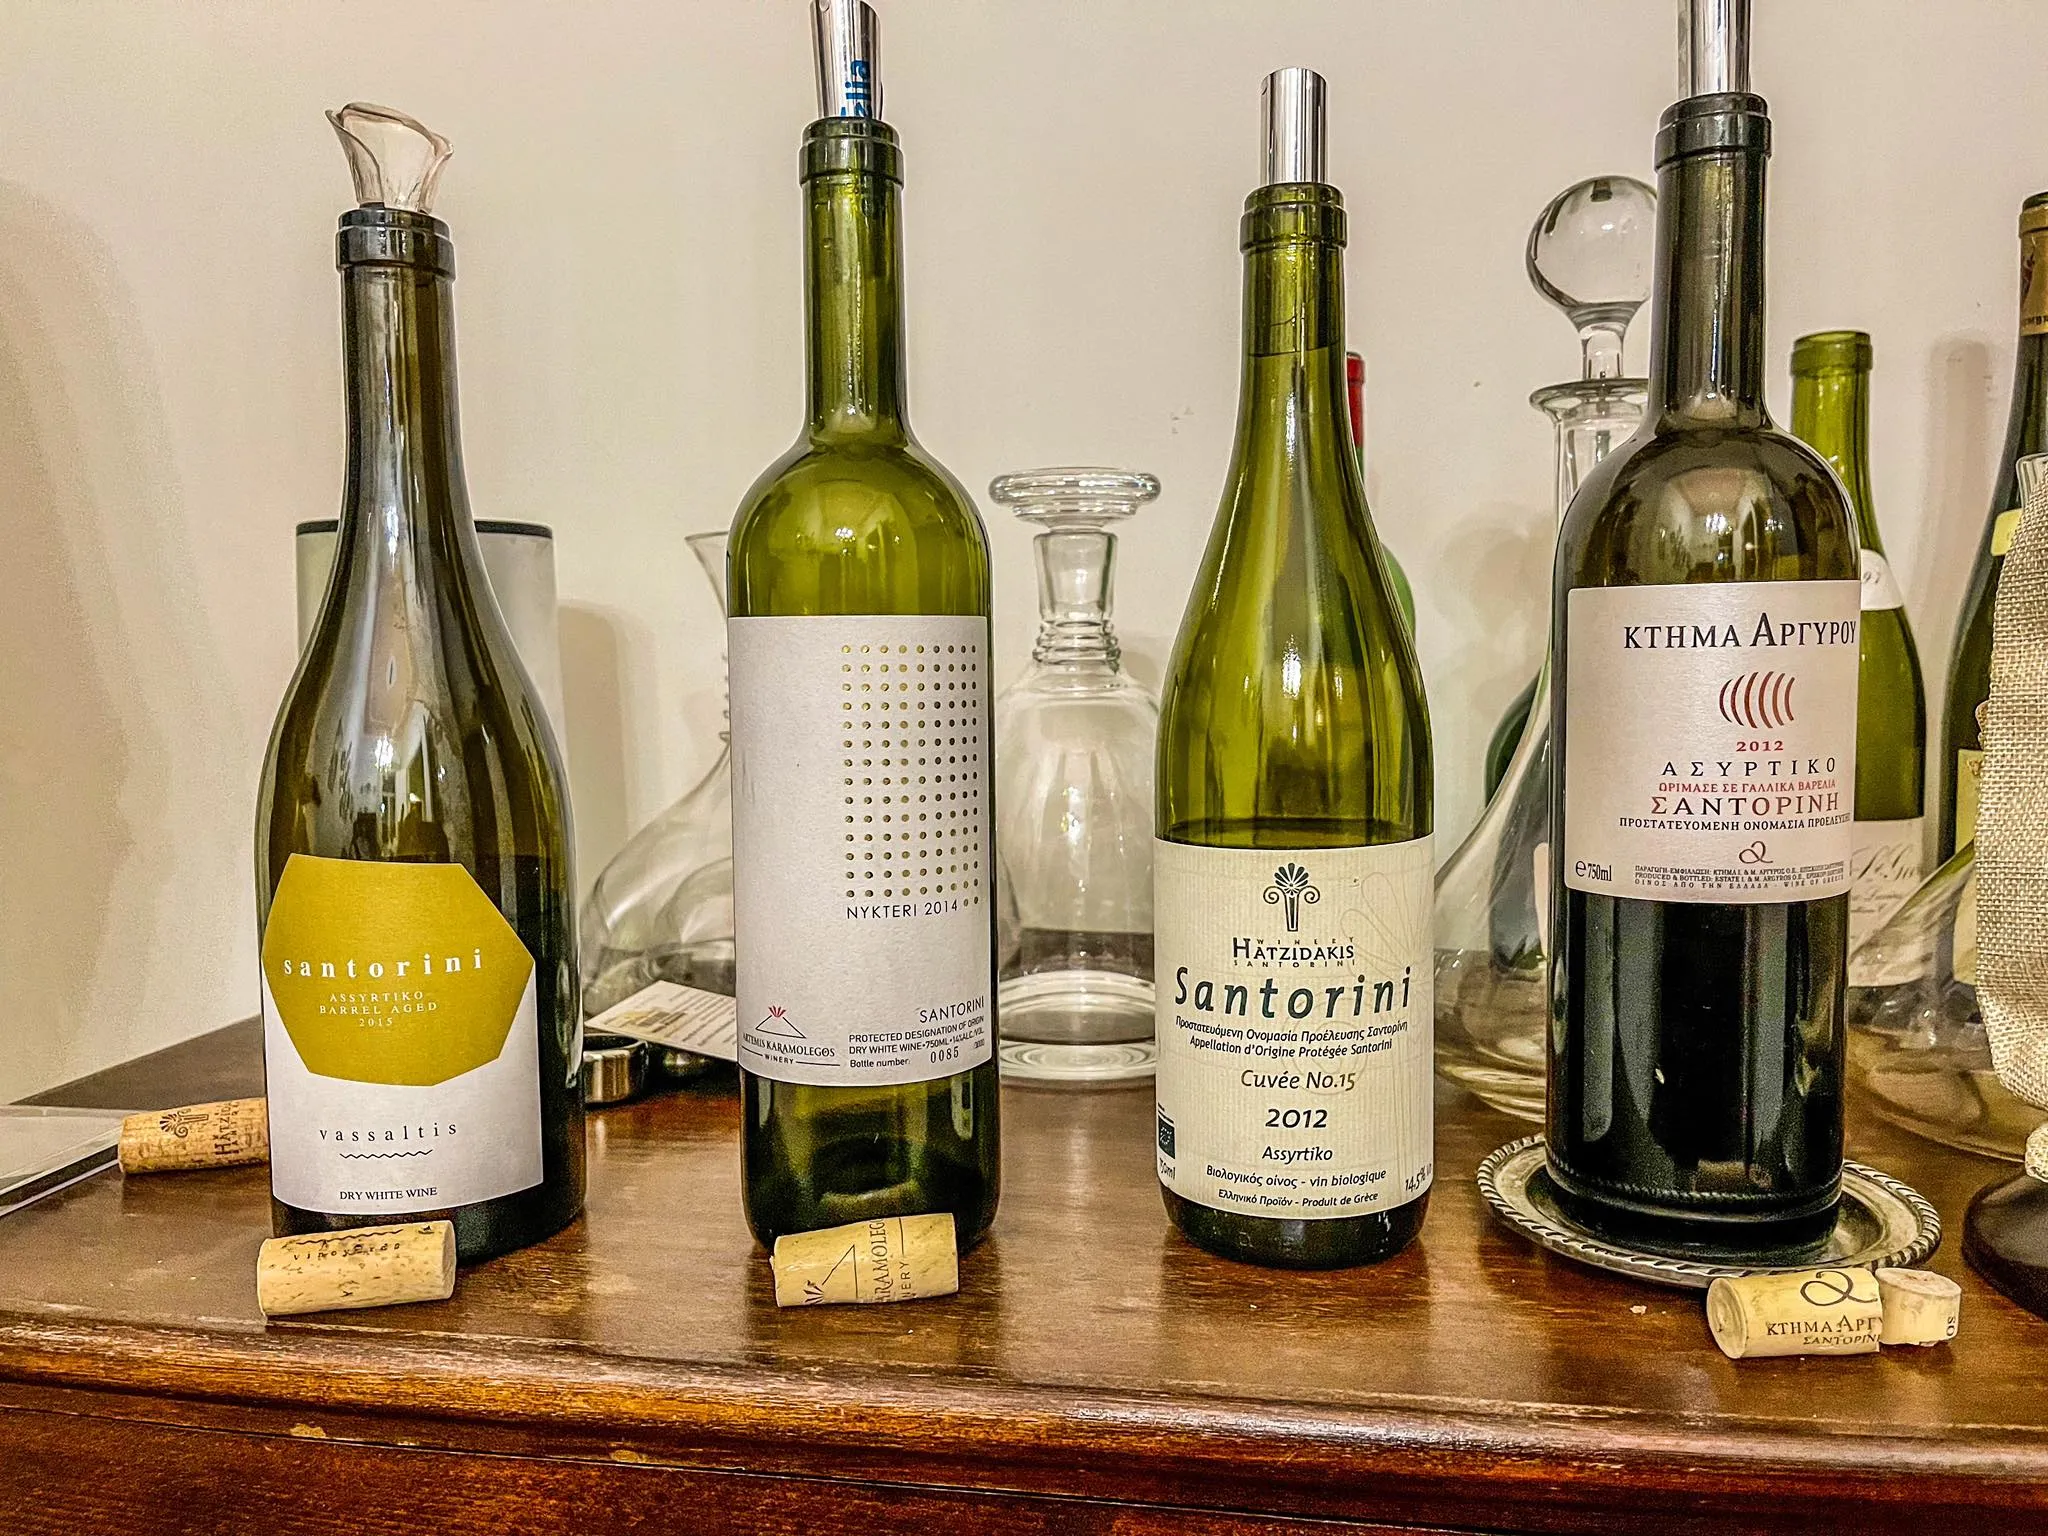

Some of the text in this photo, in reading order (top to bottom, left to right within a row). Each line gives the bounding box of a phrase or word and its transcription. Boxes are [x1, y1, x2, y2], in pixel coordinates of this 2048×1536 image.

[1624, 612, 1857, 649] ΚΤΗΜΑ ΑΡΓΥΡΟΥ
[1736, 740, 1784, 752] 2012
[1661, 757, 1836, 777] ΑΣΥΡΤΙΚΟ
[1659, 782, 1718, 793] ΩΡΙΜΑΣΕ
[1722, 783, 1738, 793] ΣΕ
[1742, 782, 1794, 793] ΓΑΛΛΙΚΑ
[1651, 792, 1839, 816] ΣΑΝΤΟΡΙΝΗ
[1620, 817, 1739, 831] ΠΡΟΣΤΑΤΕΥΟΜΕΝΗ
[1744, 818, 1805, 831] ΟΝΟΜΑΣΙΑ
[1635, 872, 1671, 881] PRODUCED
[847, 899, 957, 919] NYKTERI 2014
[1233, 937, 1354, 960] HATZIDAKIS
[284, 948, 481, 978] santorini
[1234, 959, 1355, 968] SANTORINI
[330, 991, 424, 1002] ASSYRTIKO
[1175, 966, 1411, 1019] Santorini
[320, 1002, 437, 1015] BARREL AGED
[920, 996, 984, 1023] SANTORINI
[360, 1017, 393, 1027] 2015
[849, 1032, 902, 1043] PROTECTED
[905, 1024, 958, 1040] DESIGNATION
[958, 1020, 967, 1031] OF
[1176, 1016, 1408, 1044] Προστατευόμενη Ονομασία Προέλευσης Σαντορίνη
[767, 1040, 835, 1058] KARAMOLEGOS
[849, 1046, 867, 1055] DRY
[869, 1044, 897, 1054] WHITE
[850, 1059, 874, 1068] Bottle
[930, 1046, 959, 1063] 0085
[1190, 1036, 1392, 1059] Appellation d'Origine Protégée Santorini
[764, 1054, 793, 1064] WINERY
[1241, 1069, 1356, 1091] Cuvée No.15
[1265, 1109, 1328, 1129] 2012
[320, 1122, 456, 1142] vassaltis
[1262, 1146, 1333, 1164] Assyrtiko
[1206, 1164, 1262, 1186] Βιολογικός
[1266, 1175, 1298, 1189] οίνος
[1310, 1174, 1328, 1187] vin
[1331, 1169, 1386, 1187] biologique
[340, 1187, 437, 1200] DRY WHITE WINE
[1218, 1189, 1257, 1204] Ελληνικό
[1260, 1194, 1292, 1207] Προϊόν
[1302, 1197, 1337, 1207] Produit
[1340, 1195, 1351, 1205] de
[1354, 1192, 1378, 1204] Grèce
[1767, 1320, 1832, 1336] ΚΤΗΜΑ
